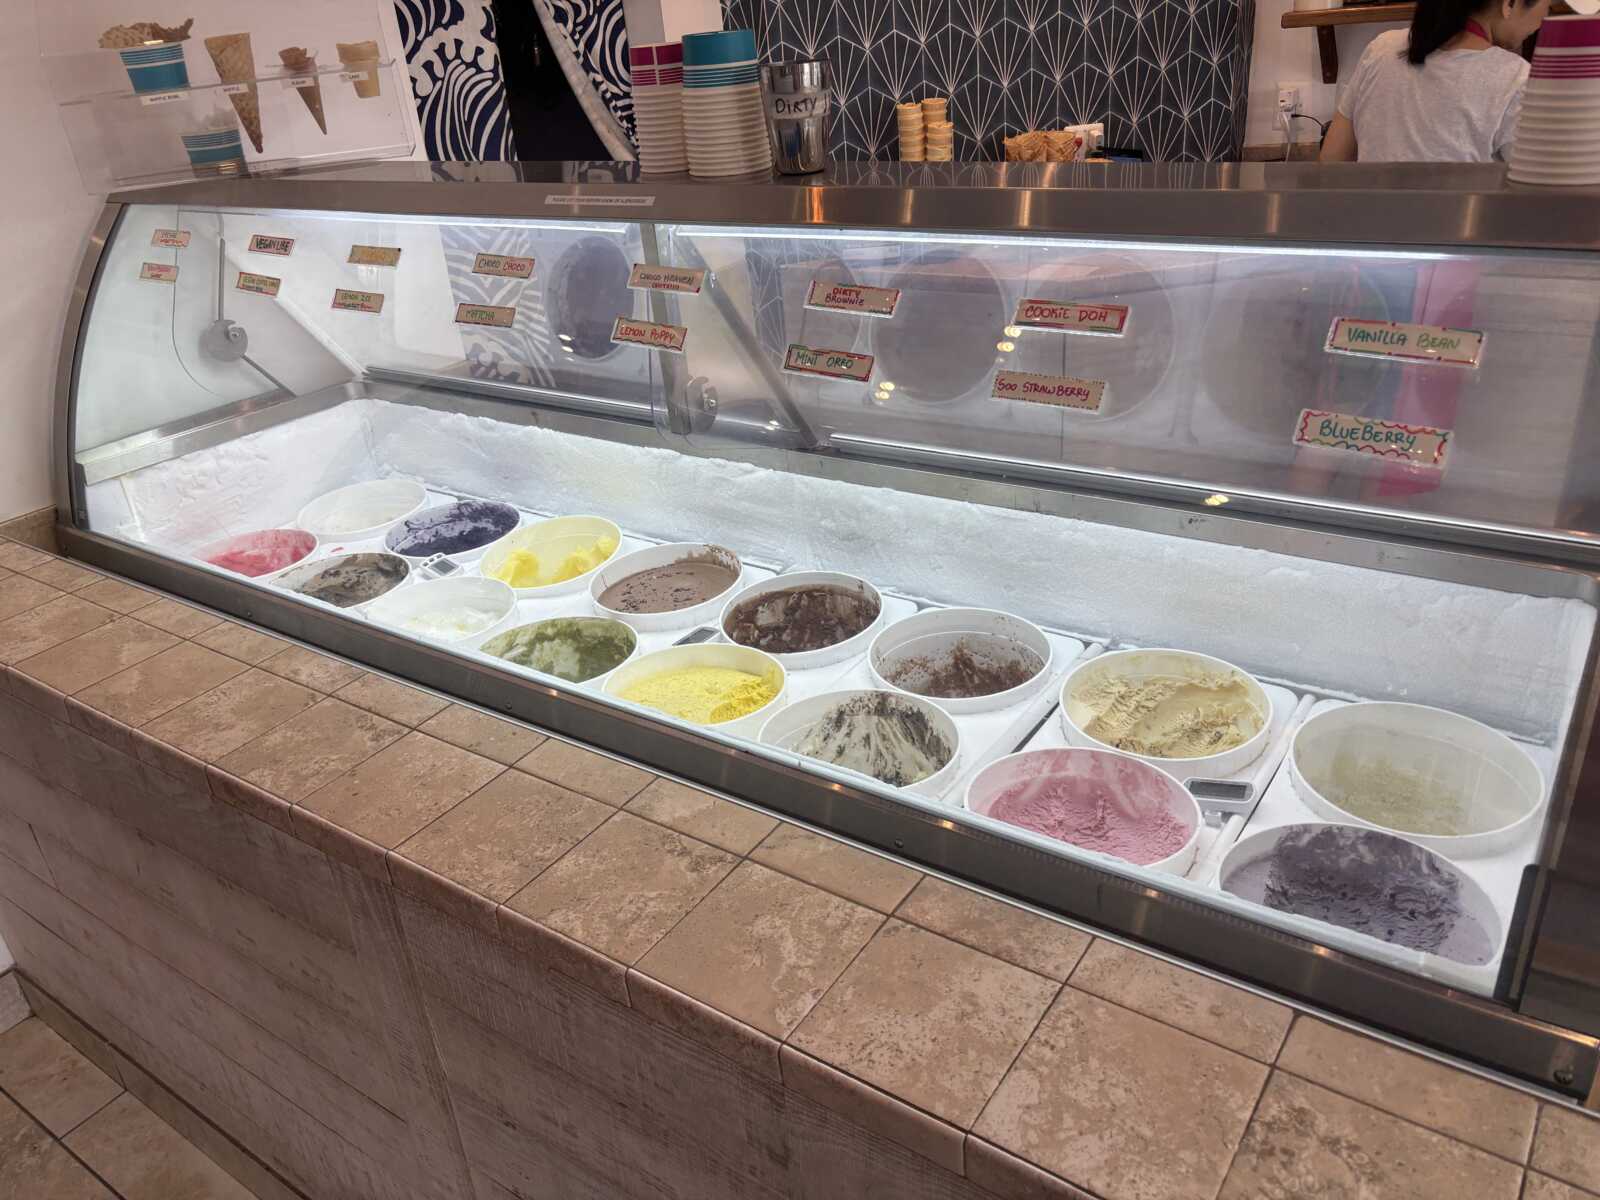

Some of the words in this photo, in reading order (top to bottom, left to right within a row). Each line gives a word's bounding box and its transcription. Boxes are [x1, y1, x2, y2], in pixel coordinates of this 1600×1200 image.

[775, 97, 817, 116] DIRTY
[255, 237, 275, 250] VEGAN
[503, 261, 526, 272] CHOCO
[825, 293, 865, 306] BROWNIE
[832, 287, 861, 297] DIRTY
[1025, 305, 1071, 319] COOKIE
[1078, 309, 1108, 322] DOH
[620, 326, 646, 337] LEMON
[650, 328, 677, 342] POPPY
[1347, 327, 1408, 346] VANILLA
[1417, 333, 1461, 350] BEAN
[795, 351, 818, 367] MINT
[826, 357, 854, 369] OREO
[1022, 382, 1091, 402] STRAWBERRY
[1319, 418, 1417, 452] BLUEBERRY
